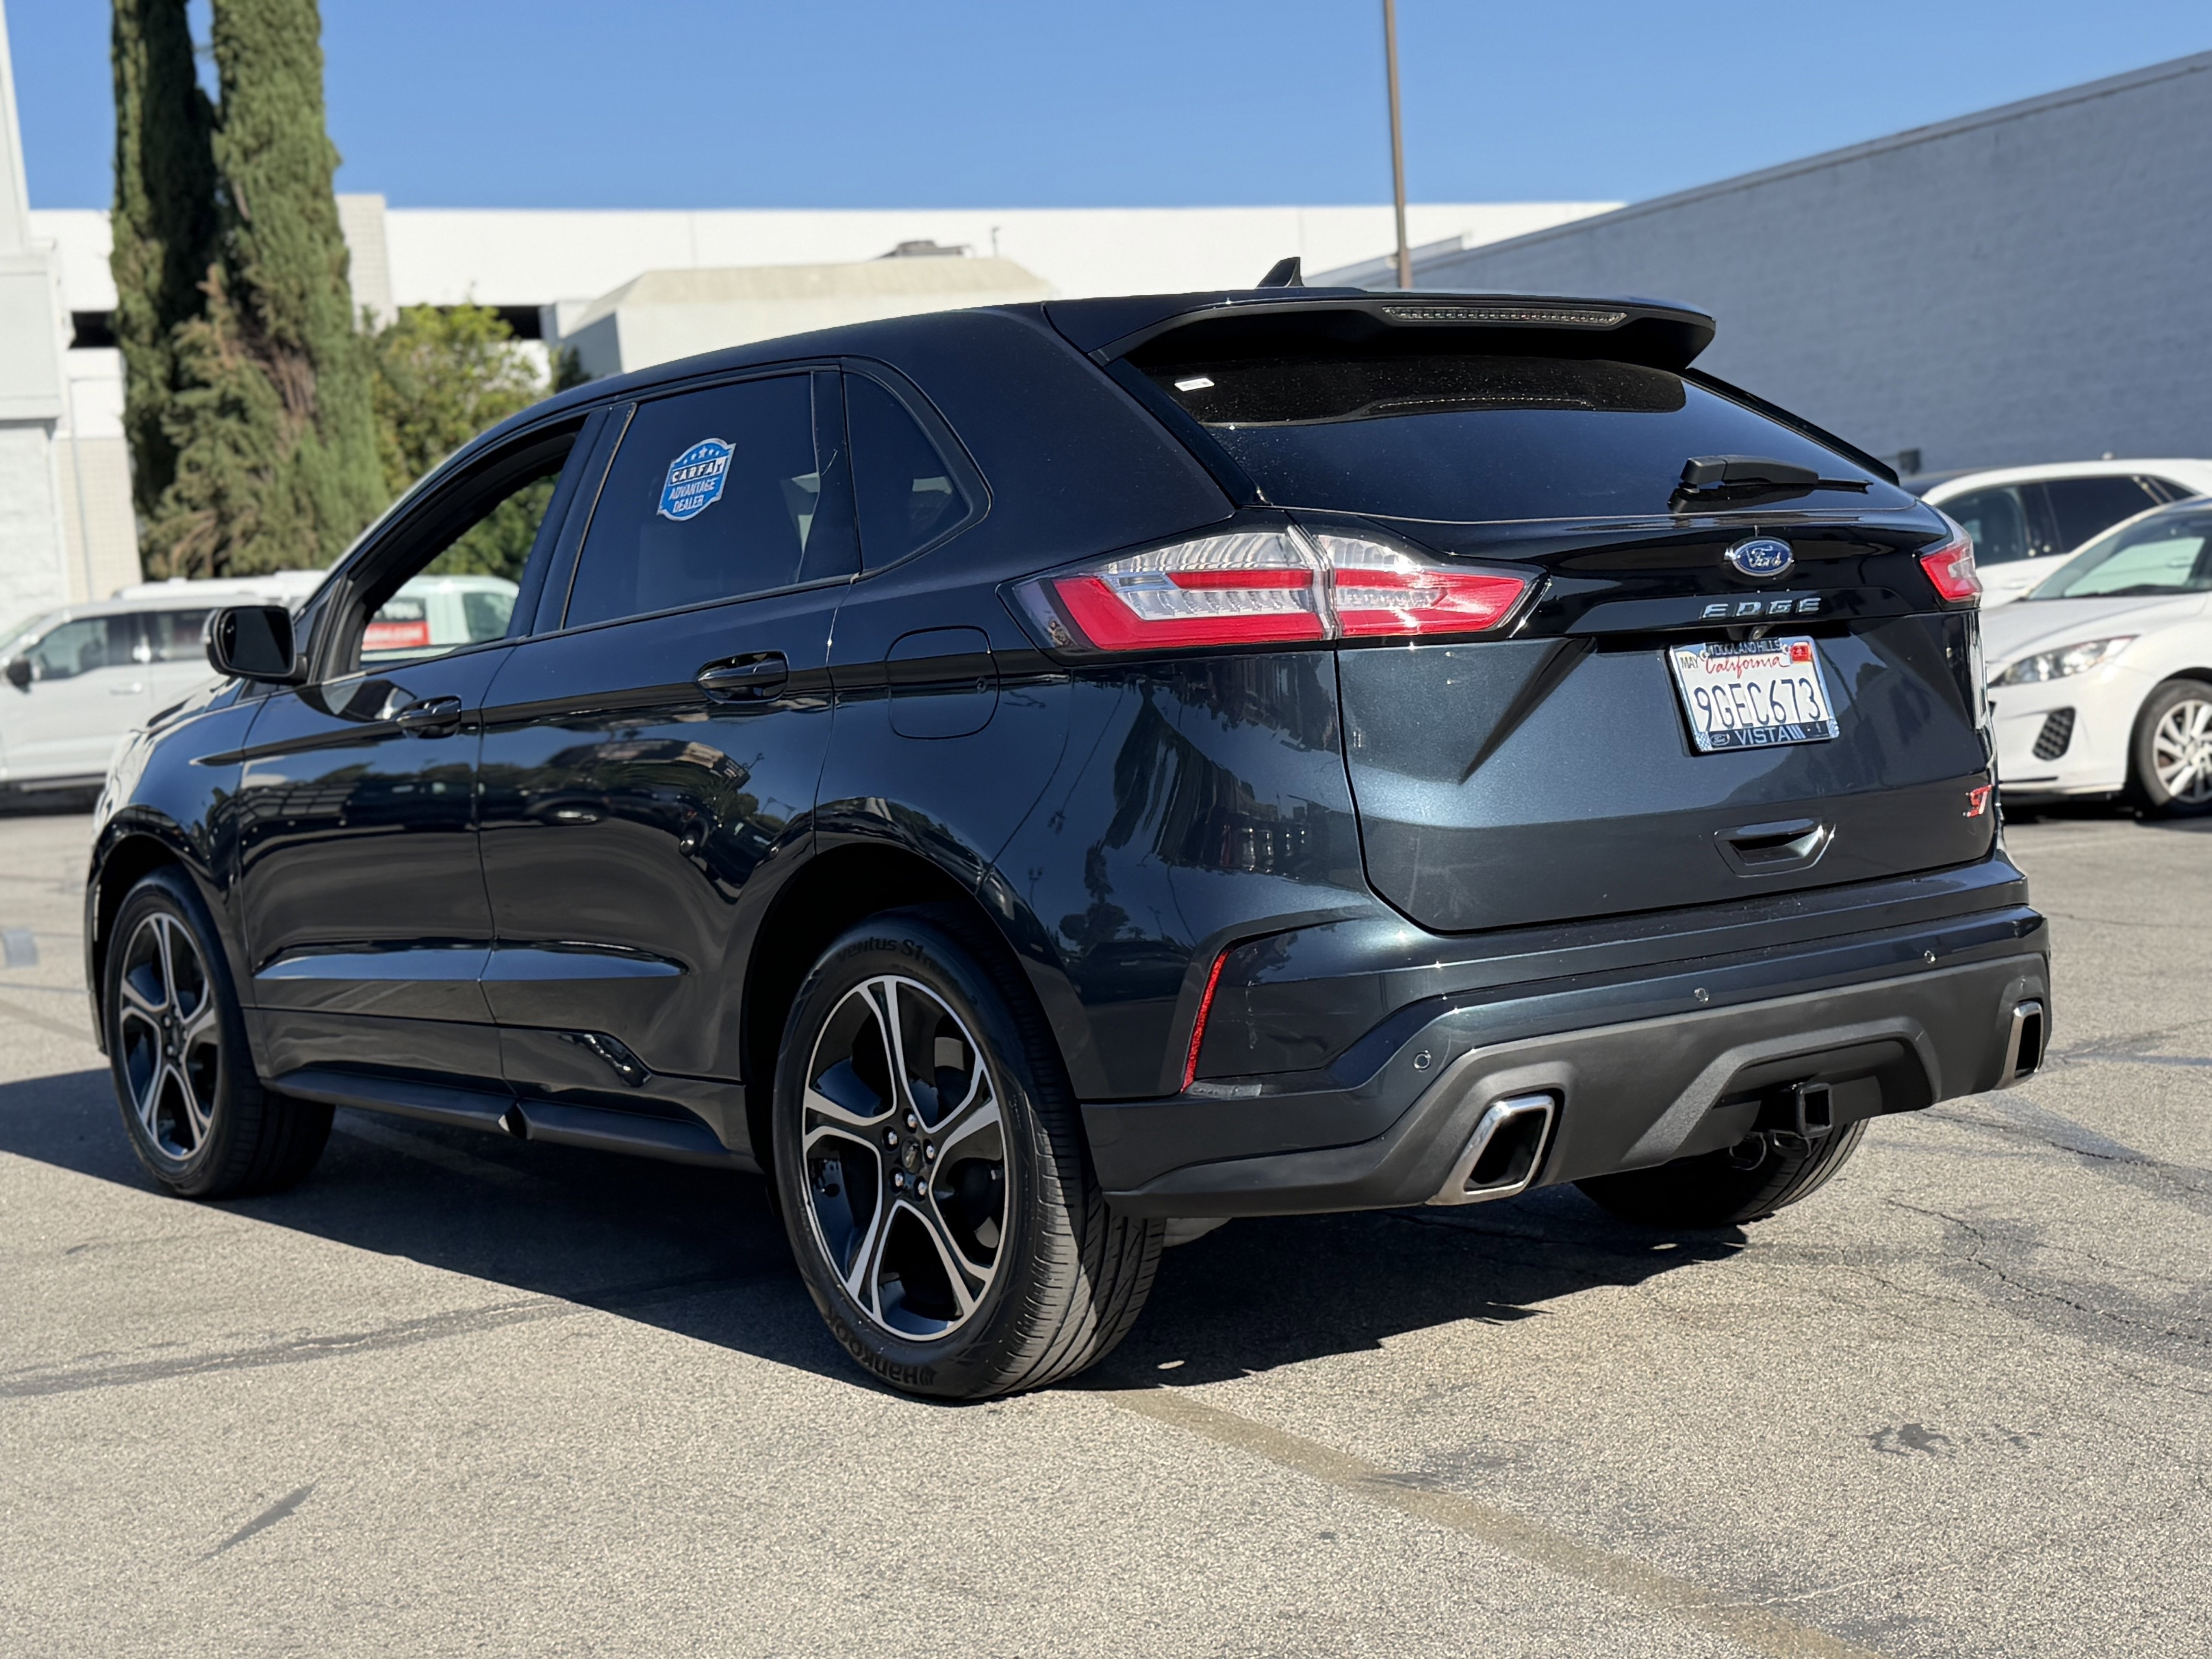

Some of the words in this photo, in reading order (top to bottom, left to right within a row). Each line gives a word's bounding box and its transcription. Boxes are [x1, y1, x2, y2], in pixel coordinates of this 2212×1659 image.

[672, 457, 727, 483] CARFAX
[669, 477, 719, 501] ADVANTAGE
[672, 494, 704, 514] DEALER
[1745, 545, 1782, 568] Ford
[1701, 598, 1821, 618] EDGE
[1681, 656, 1699, 670] MAY
[1705, 655, 1790, 679] California
[1693, 677, 1821, 732] 9GEC673
[1734, 726, 1790, 745] VISTA
